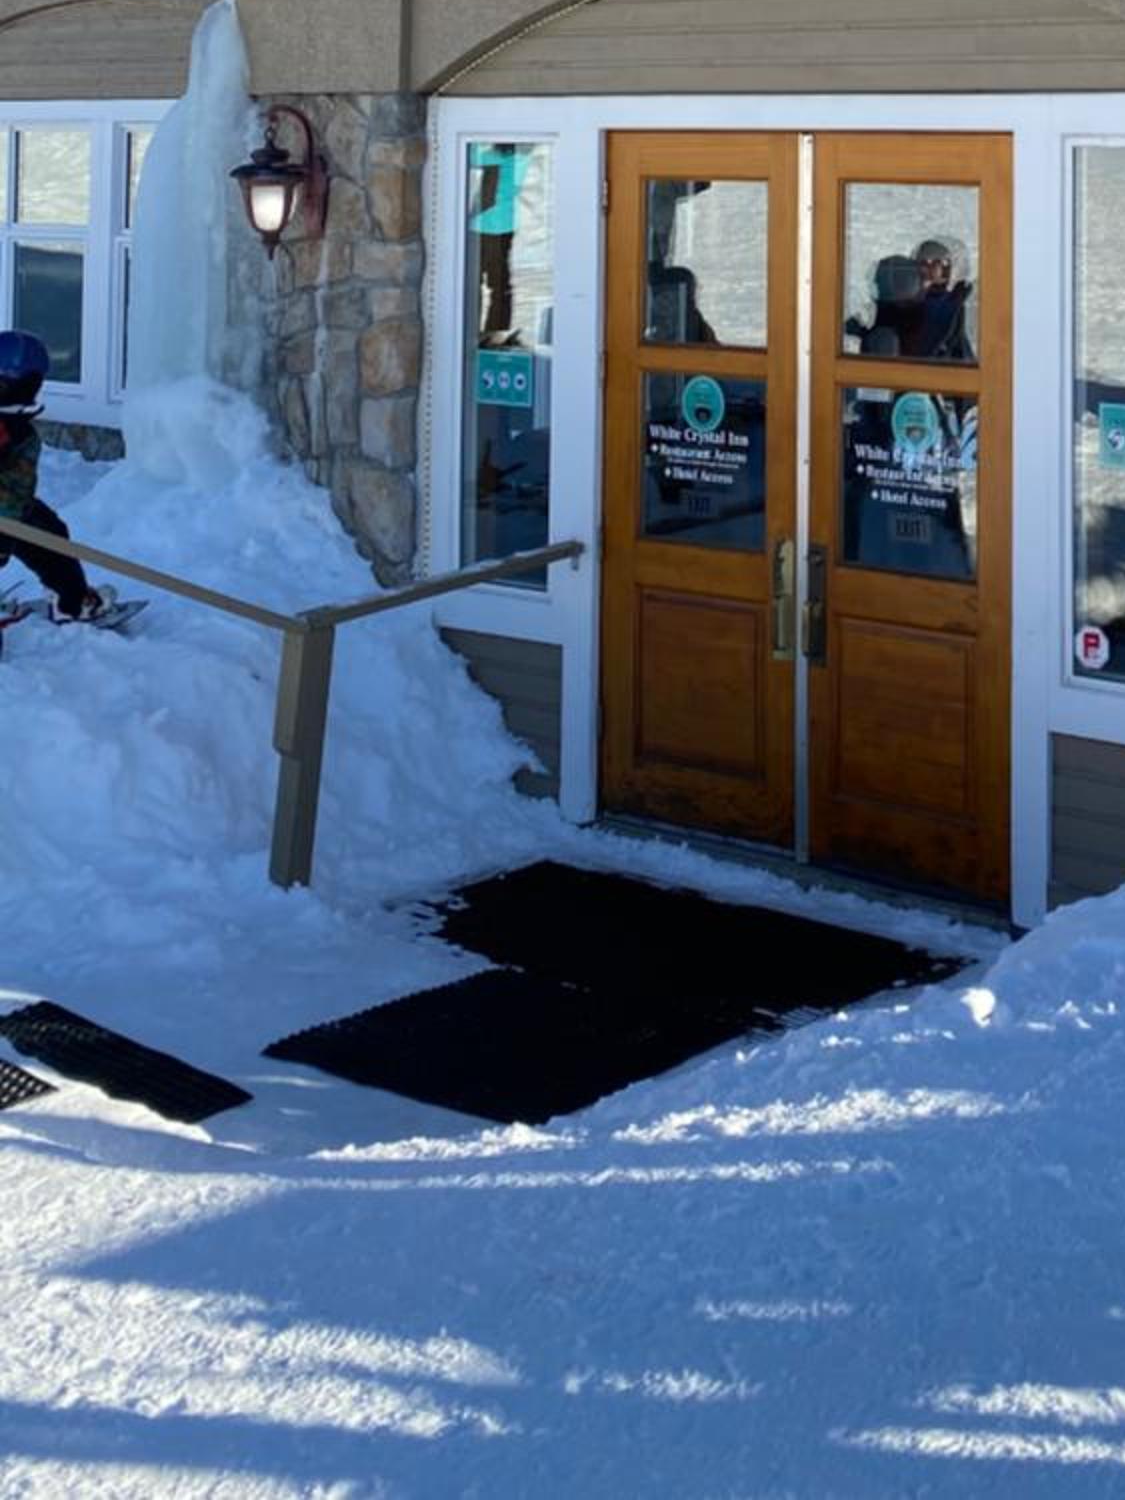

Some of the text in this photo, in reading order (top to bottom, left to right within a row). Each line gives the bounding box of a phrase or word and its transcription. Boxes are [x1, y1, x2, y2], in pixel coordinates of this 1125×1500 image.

[684, 427, 725, 446] Crystal
[728, 432, 749, 446] Inn
[855, 445, 890, 462] White
